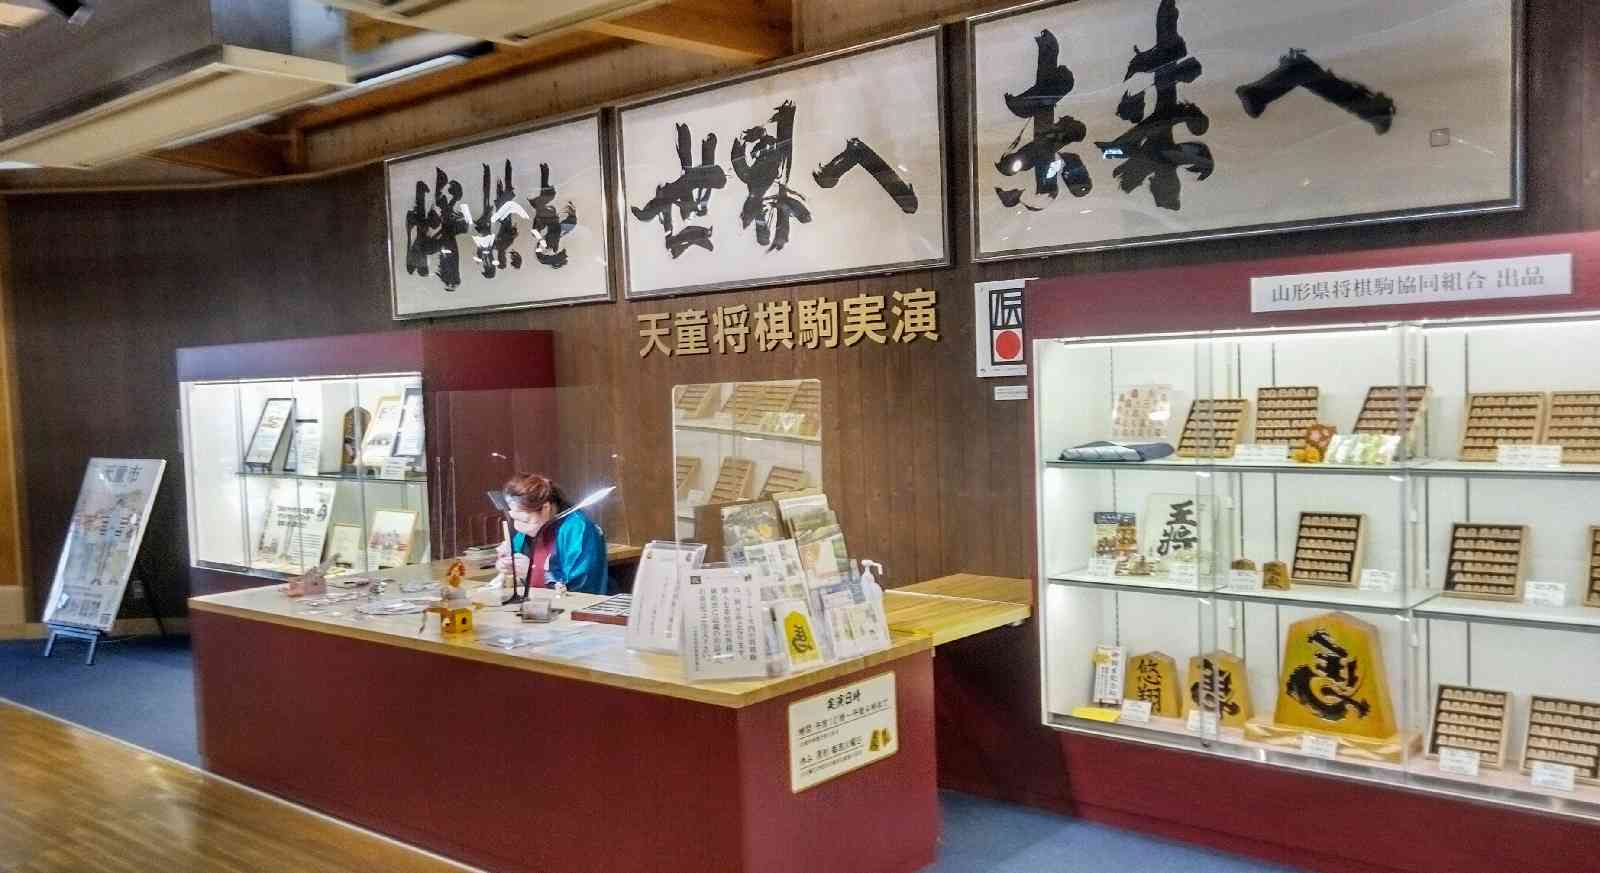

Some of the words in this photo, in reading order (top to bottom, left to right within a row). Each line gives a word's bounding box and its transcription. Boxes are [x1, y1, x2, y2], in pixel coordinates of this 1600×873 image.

[630, 100, 919, 259] 世界へ
[1271, 270, 1489, 303] 山形県将棋駒協同組合
[1496, 265, 1545, 289] 出品
[637, 288, 941, 358] 天童将棋駒実演
